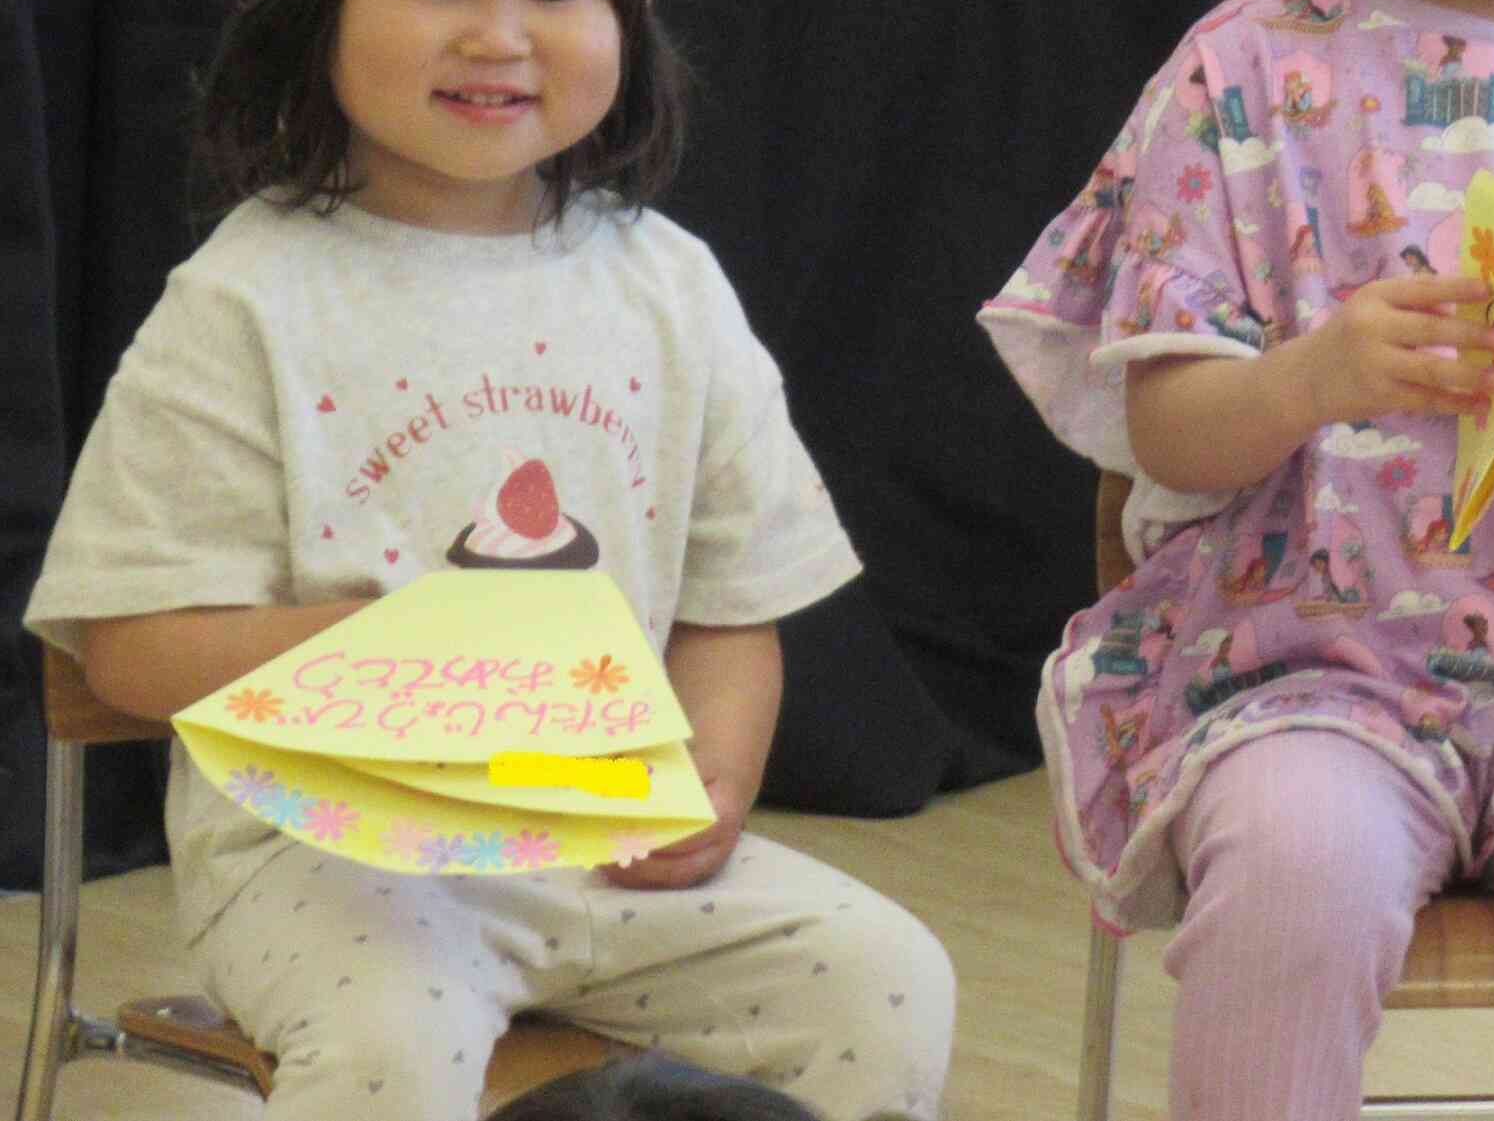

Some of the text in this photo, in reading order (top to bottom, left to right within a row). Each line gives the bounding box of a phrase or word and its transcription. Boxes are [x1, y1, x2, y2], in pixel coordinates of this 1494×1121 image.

[346, 373, 646, 504] sweet strawberry
[292, 653, 554, 699] おめでとう
